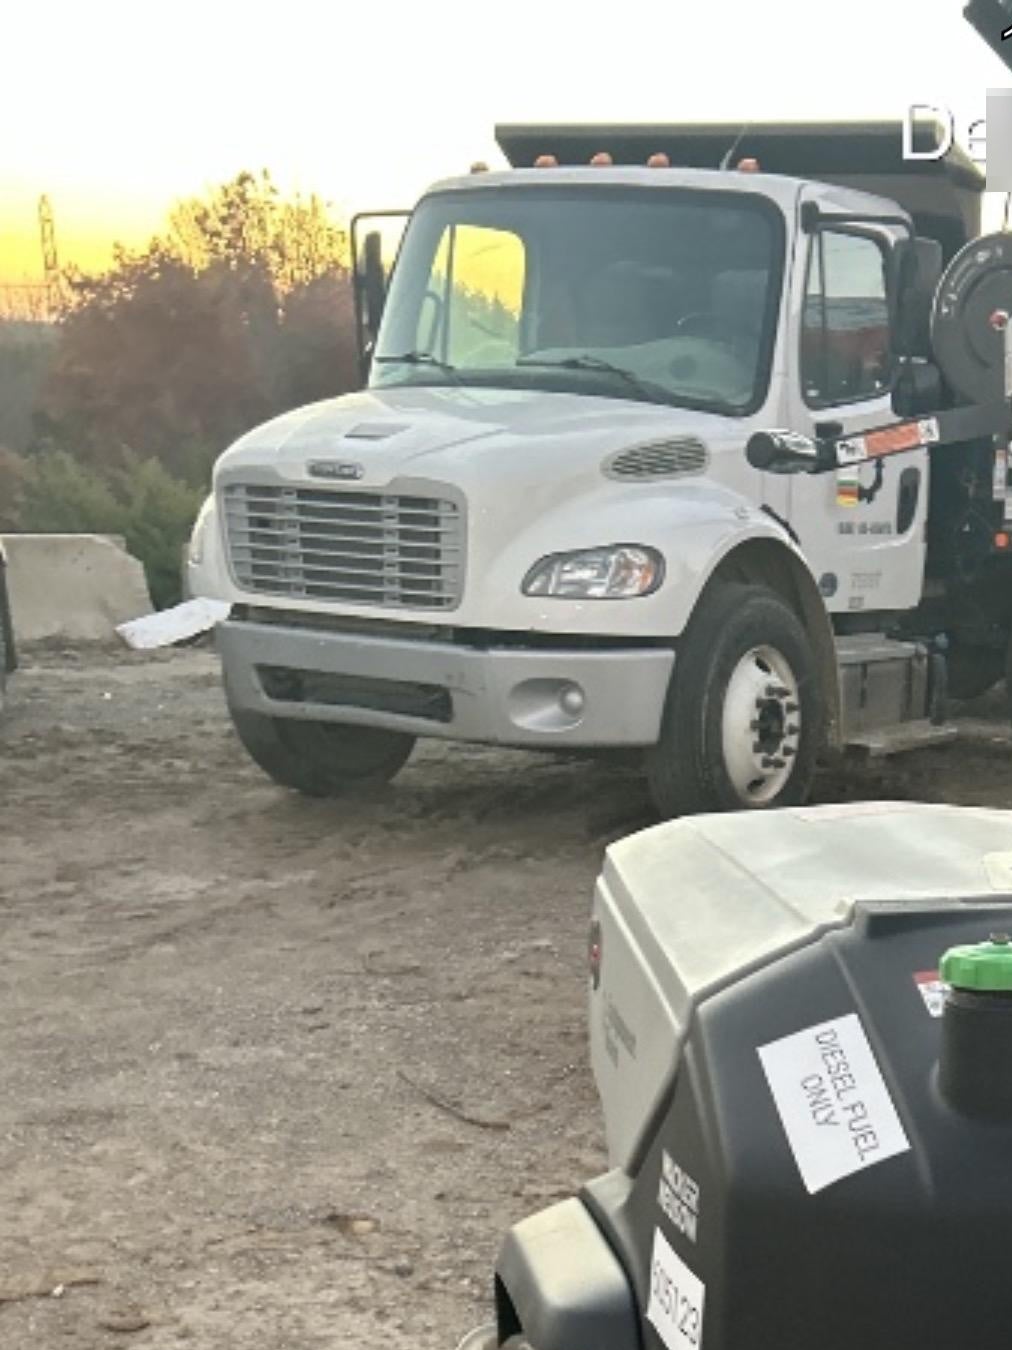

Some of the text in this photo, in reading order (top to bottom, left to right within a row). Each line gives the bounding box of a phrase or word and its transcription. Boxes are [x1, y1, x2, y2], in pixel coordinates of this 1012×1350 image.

[800, 1072, 841, 1127] ONLY
[815, 1028, 880, 1162] DIESEL FUEL
